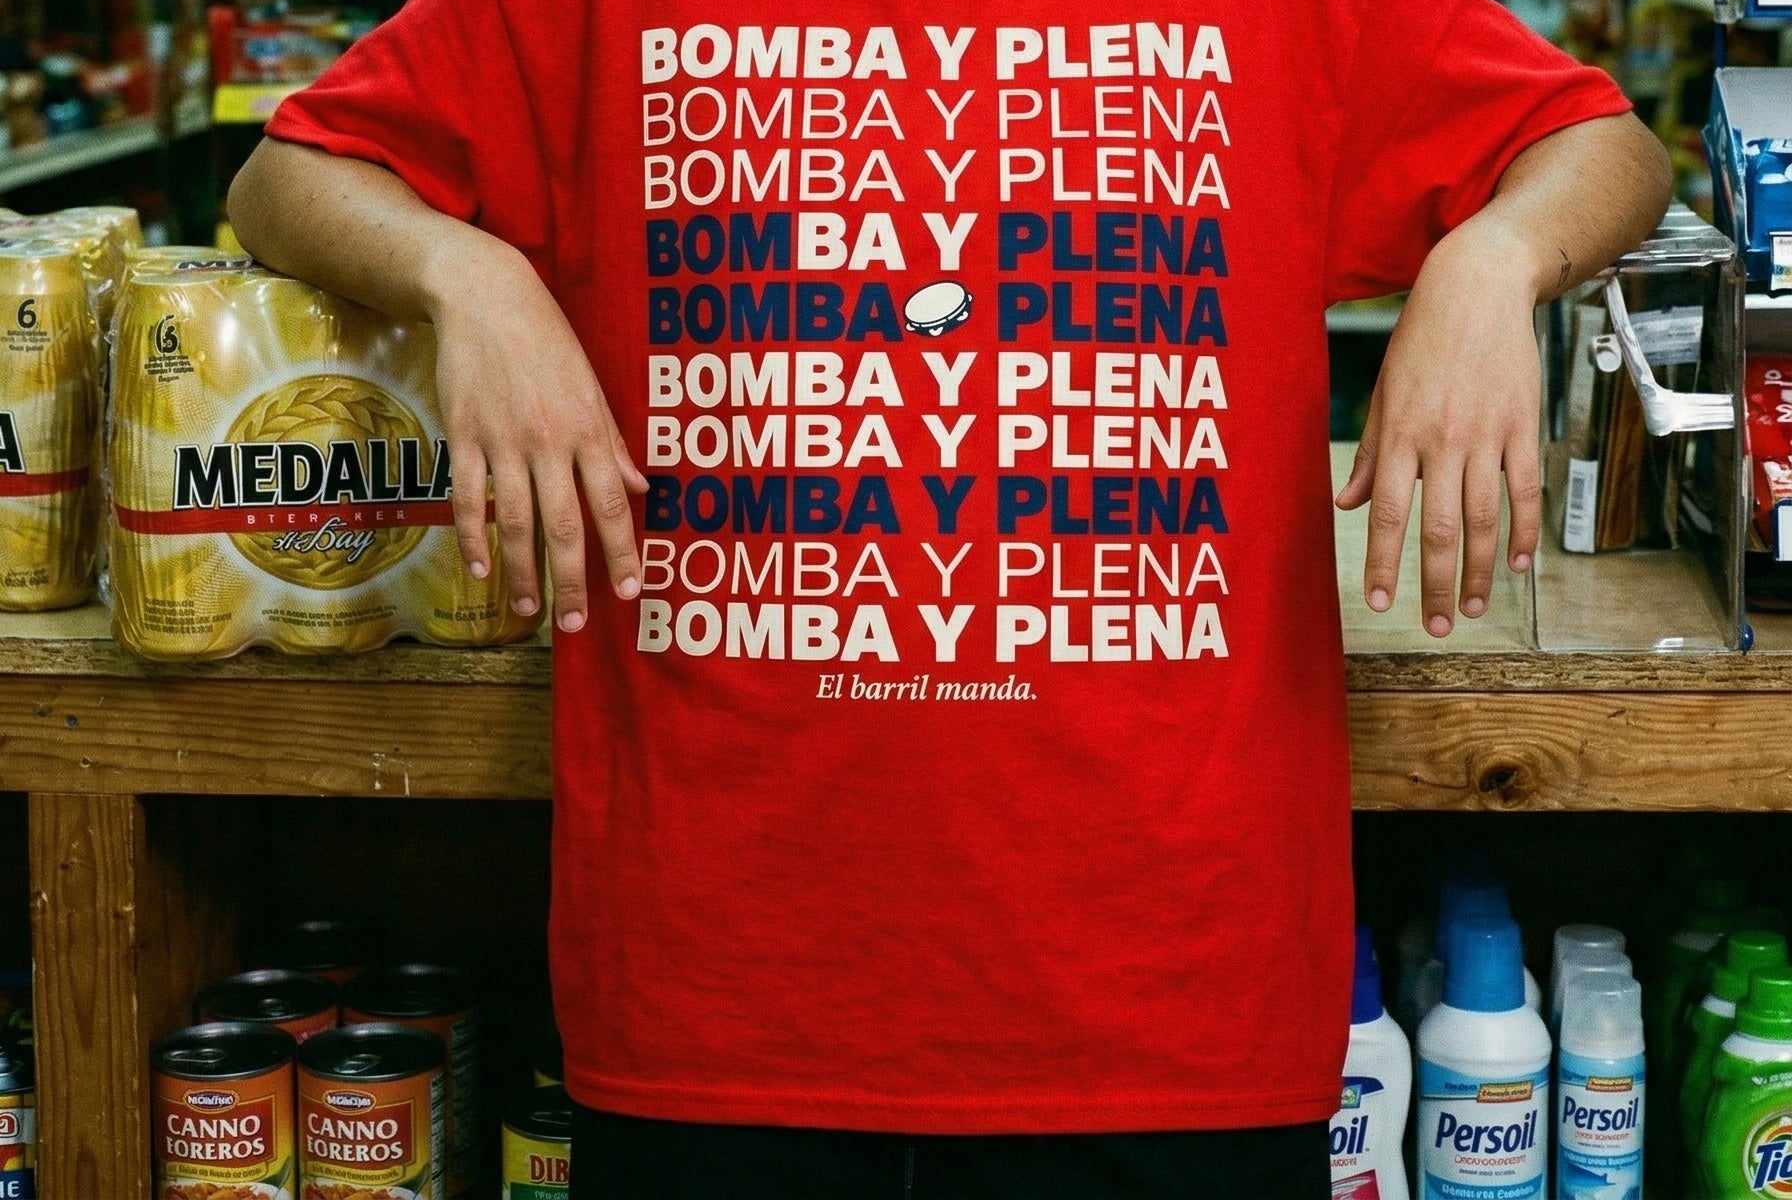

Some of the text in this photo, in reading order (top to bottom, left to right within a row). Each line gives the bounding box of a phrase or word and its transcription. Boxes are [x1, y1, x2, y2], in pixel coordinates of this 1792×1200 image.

[641, 22, 1232, 85] BOMBA Y PLENA
[643, 85, 1231, 147] BOMBA Y PLENA
[644, 146, 1230, 210] BOMBA Y PLENA
[645, 211, 1228, 278] BOMBA Y PLENA
[17, 299, 37, 330] 6
[648, 281, 1227, 347] BOMBA PLENA
[648, 351, 1228, 410] BOMBA Y PLENA
[647, 414, 1228, 469] BOMBA Y PLENA
[644, 474, 1229, 536] BOMBA Y PLENA
[640, 538, 1229, 598] BOMBA Y PLENA
[636, 598, 1229, 663] BOMBA Y PLENA
[815, 673, 1037, 700] El barril manda.
[166, 1114, 261, 1139] CANNO
[307, 1112, 399, 1141] CANNO
[1434, 1109, 1538, 1155] Persoil
[1562, 1096, 1639, 1131] Persoil
